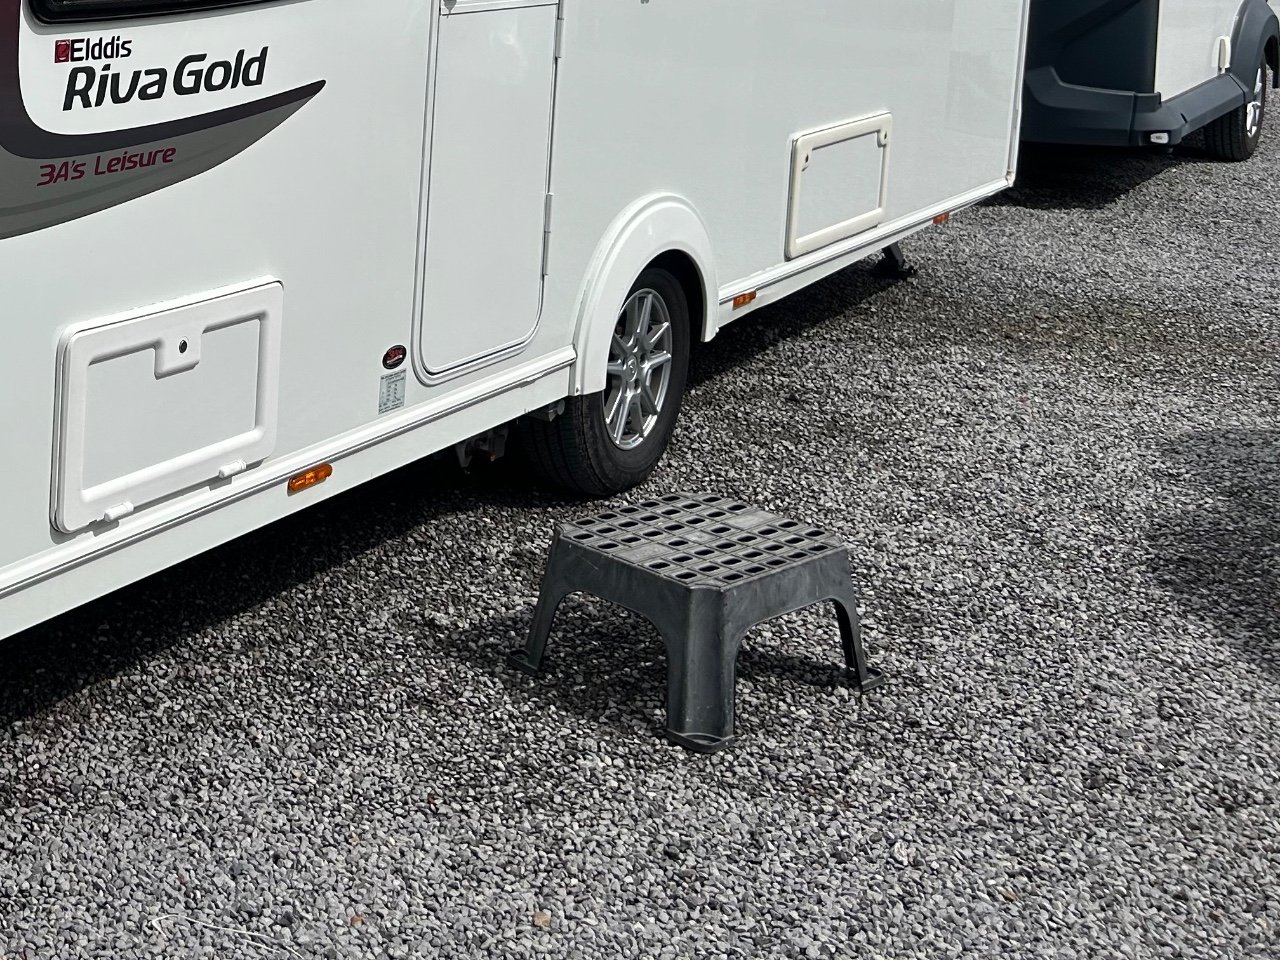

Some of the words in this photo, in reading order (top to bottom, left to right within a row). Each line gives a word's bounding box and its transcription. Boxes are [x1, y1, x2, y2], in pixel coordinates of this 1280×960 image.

[70, 36, 133, 61] Elddis
[62, 63, 168, 111] Riva
[172, 46, 269, 96] Gold
[36, 159, 87, 187] 3A's
[94, 147, 177, 176] Leisure
